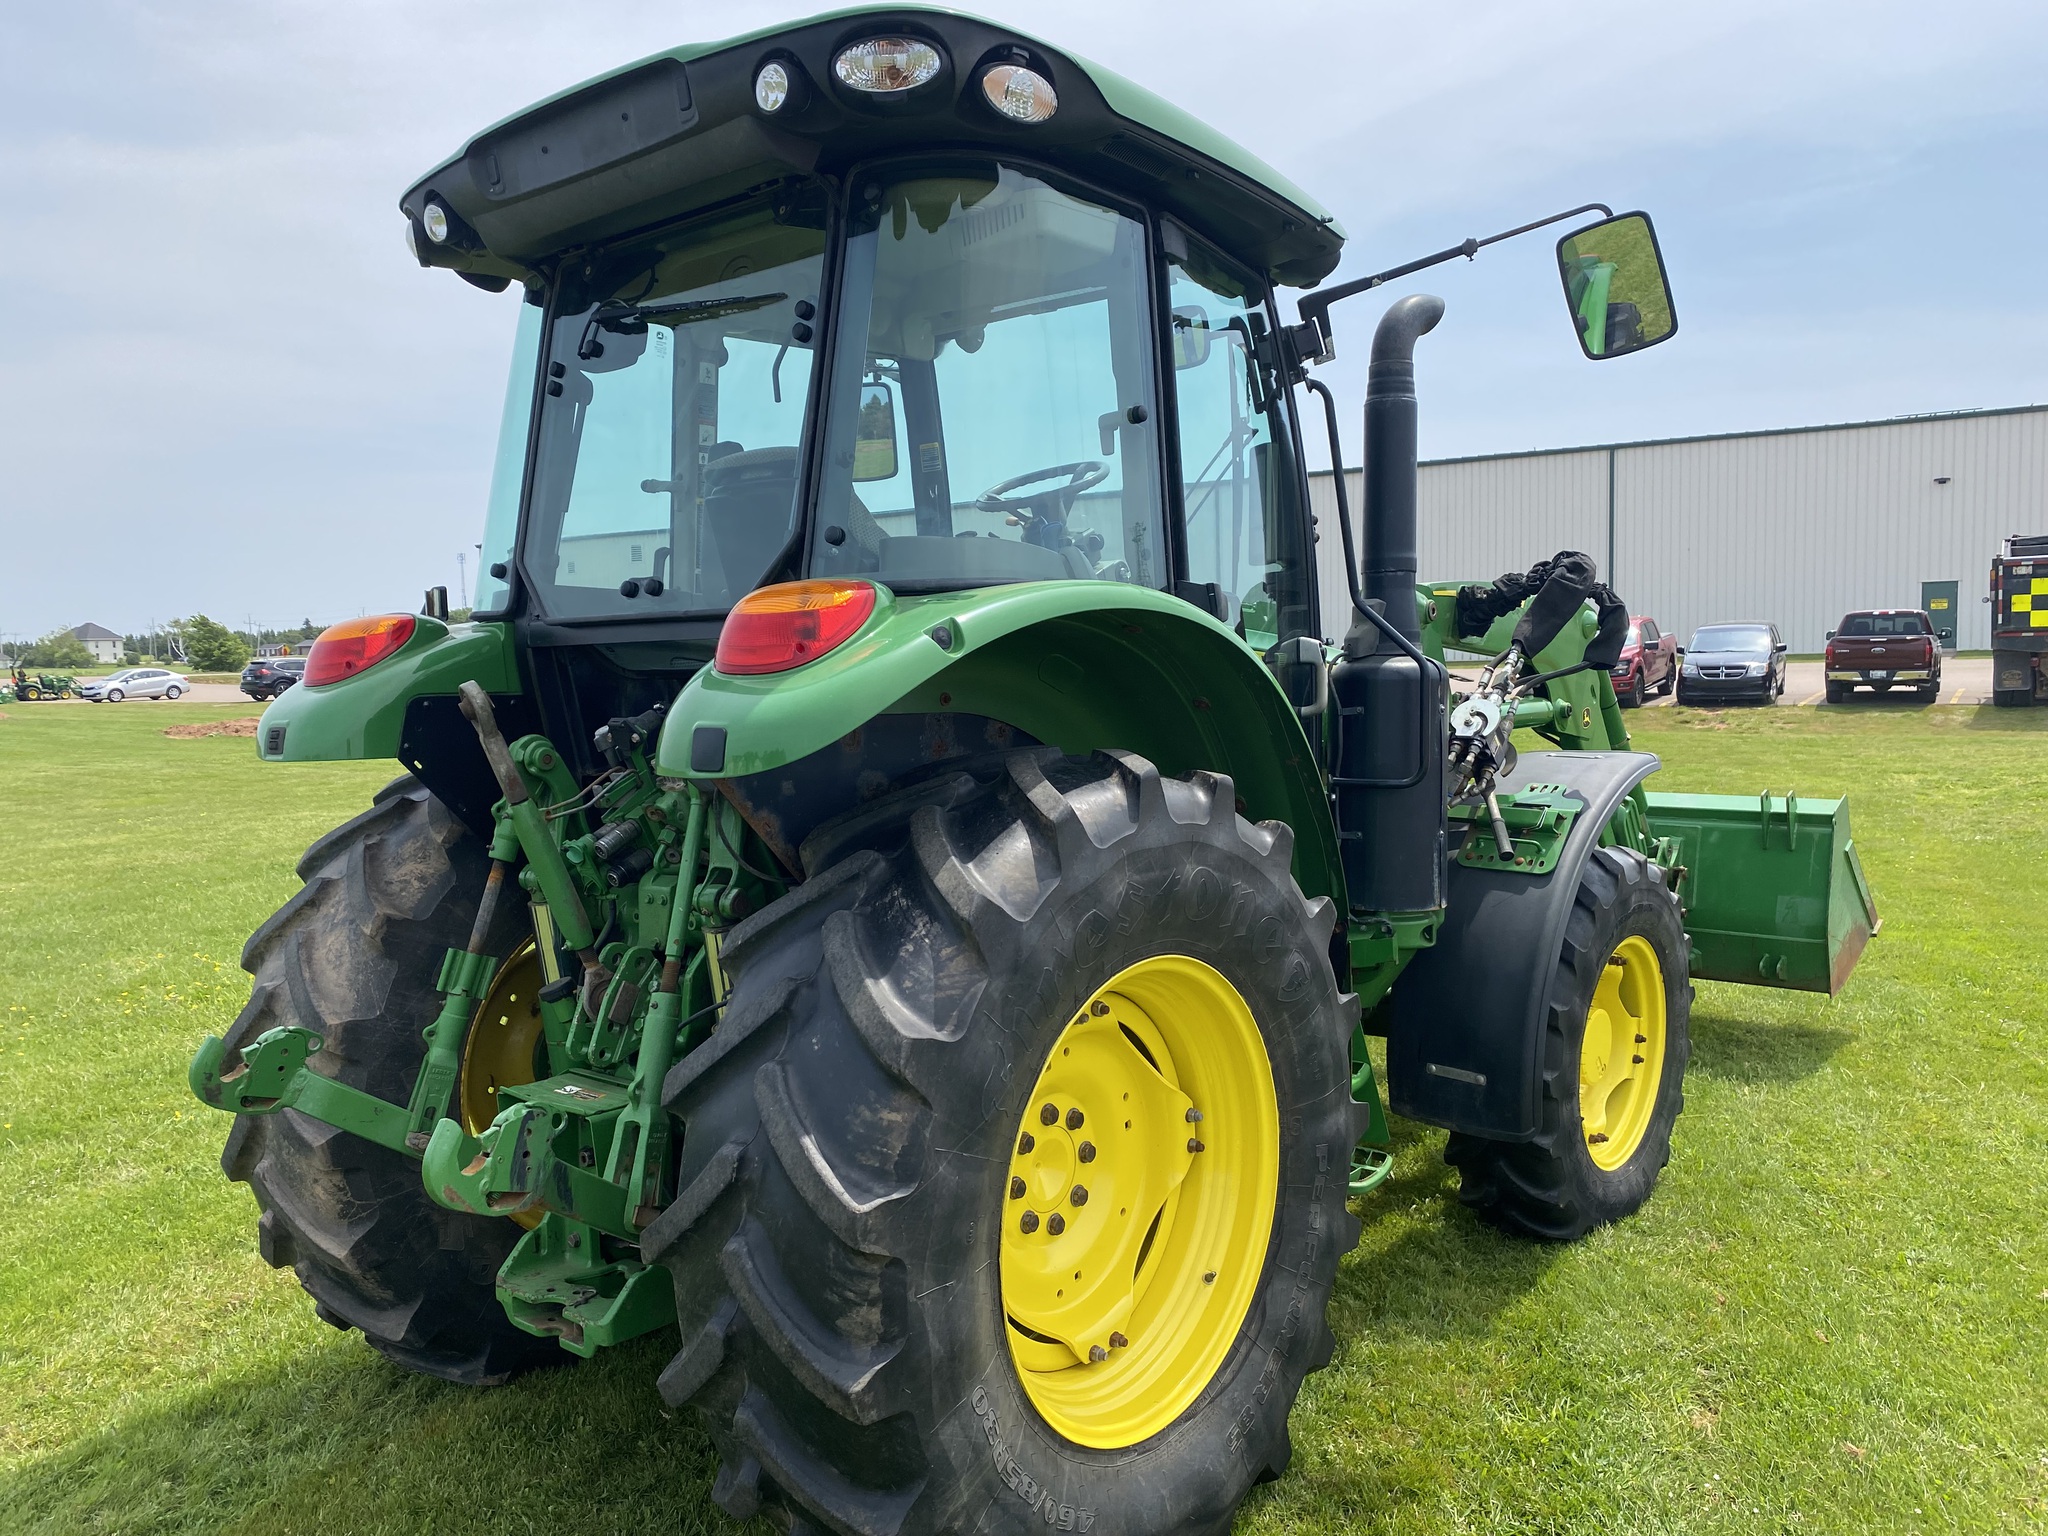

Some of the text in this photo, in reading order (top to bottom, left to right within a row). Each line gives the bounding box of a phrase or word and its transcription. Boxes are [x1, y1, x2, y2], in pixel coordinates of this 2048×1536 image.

[1226, 1143, 1330, 1453] PERFORMER 85
[971, 1385, 1096, 1532] 460/85R30
